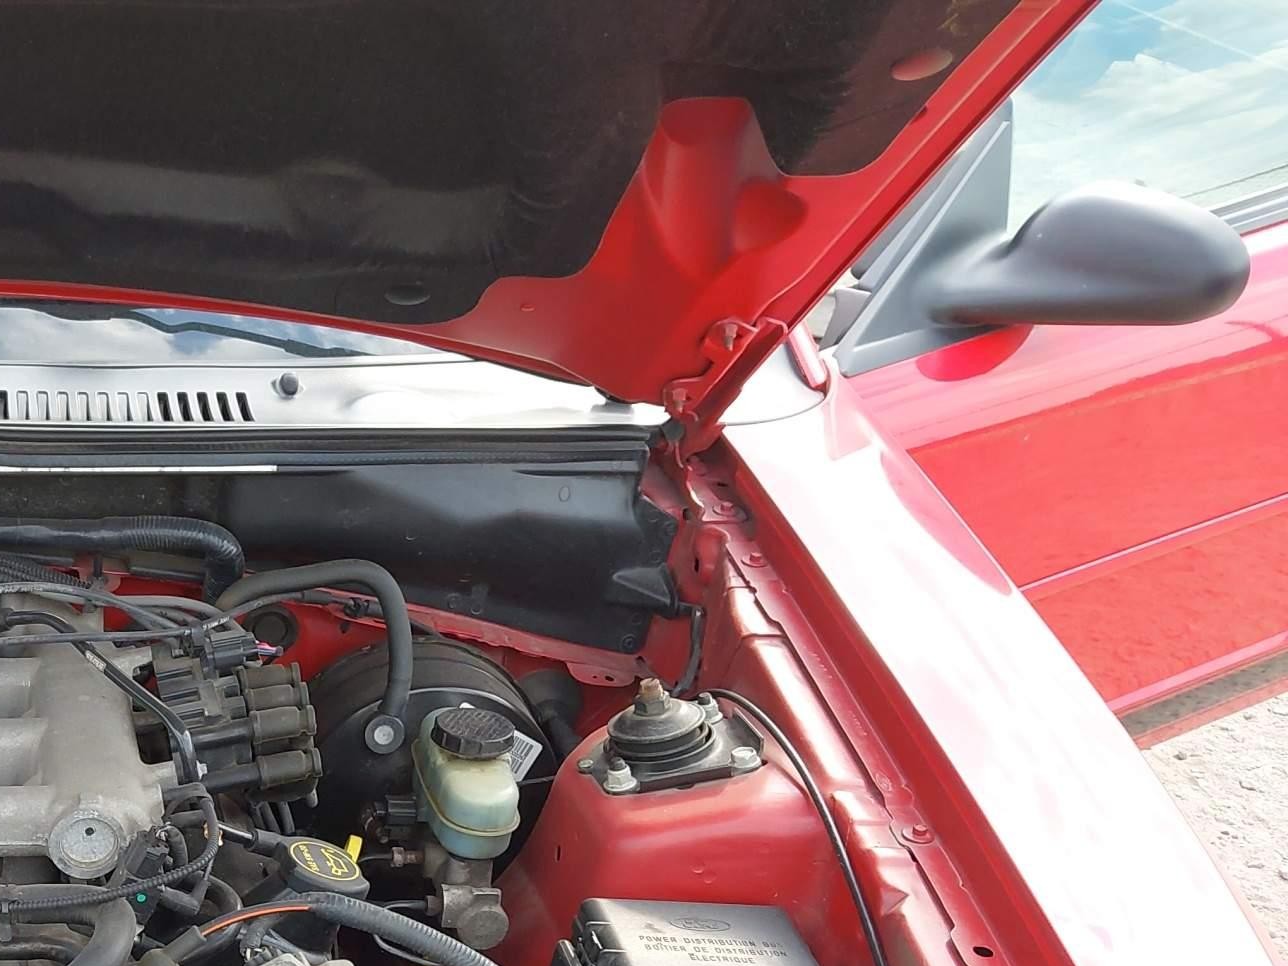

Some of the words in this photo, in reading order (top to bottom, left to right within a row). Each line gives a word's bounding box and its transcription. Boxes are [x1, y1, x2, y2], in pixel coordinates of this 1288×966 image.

[638, 935, 678, 943] POWER
[684, 938, 756, 948] DISTRIBUTION
[695, 946, 710, 954] DE
[715, 947, 788, 957] DISTRIBUTION
